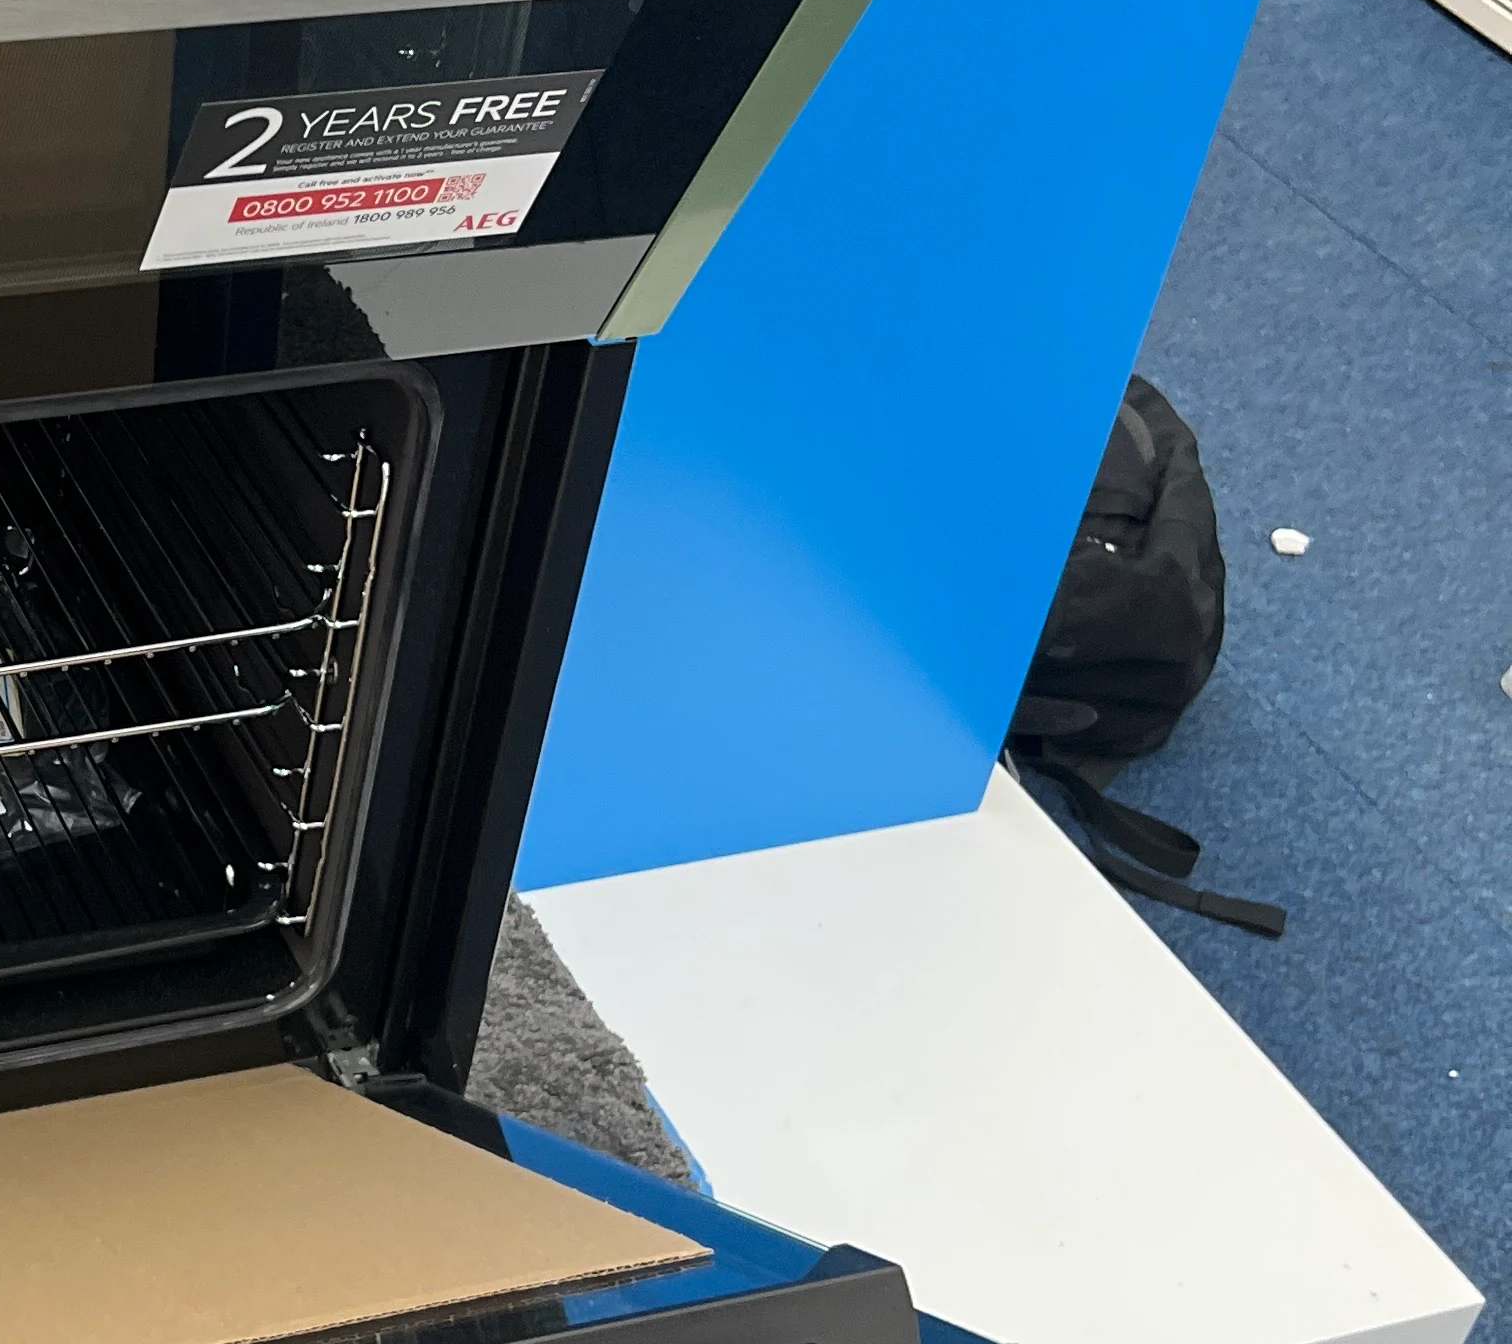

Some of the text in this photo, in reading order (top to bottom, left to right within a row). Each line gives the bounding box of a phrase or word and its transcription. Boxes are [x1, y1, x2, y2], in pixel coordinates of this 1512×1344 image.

[203, 107, 284, 180] 2
[300, 100, 442, 139] YEARS
[448, 88, 568, 125] FREE
[280, 139, 344, 154] REGISTER
[344, 136, 375, 148] AND
[376, 131, 430, 145] EXTEND
[432, 127, 469, 140] YOUR
[297, 180, 317, 189] Call
[318, 177, 339, 186] free
[341, 175, 361, 185] and
[362, 172, 402, 183] activate
[242, 184, 429, 218] 0800 952 1100
[234, 204, 457, 237] Republic of Ireland 1800 989 956
[452, 209, 520, 233] AEG
